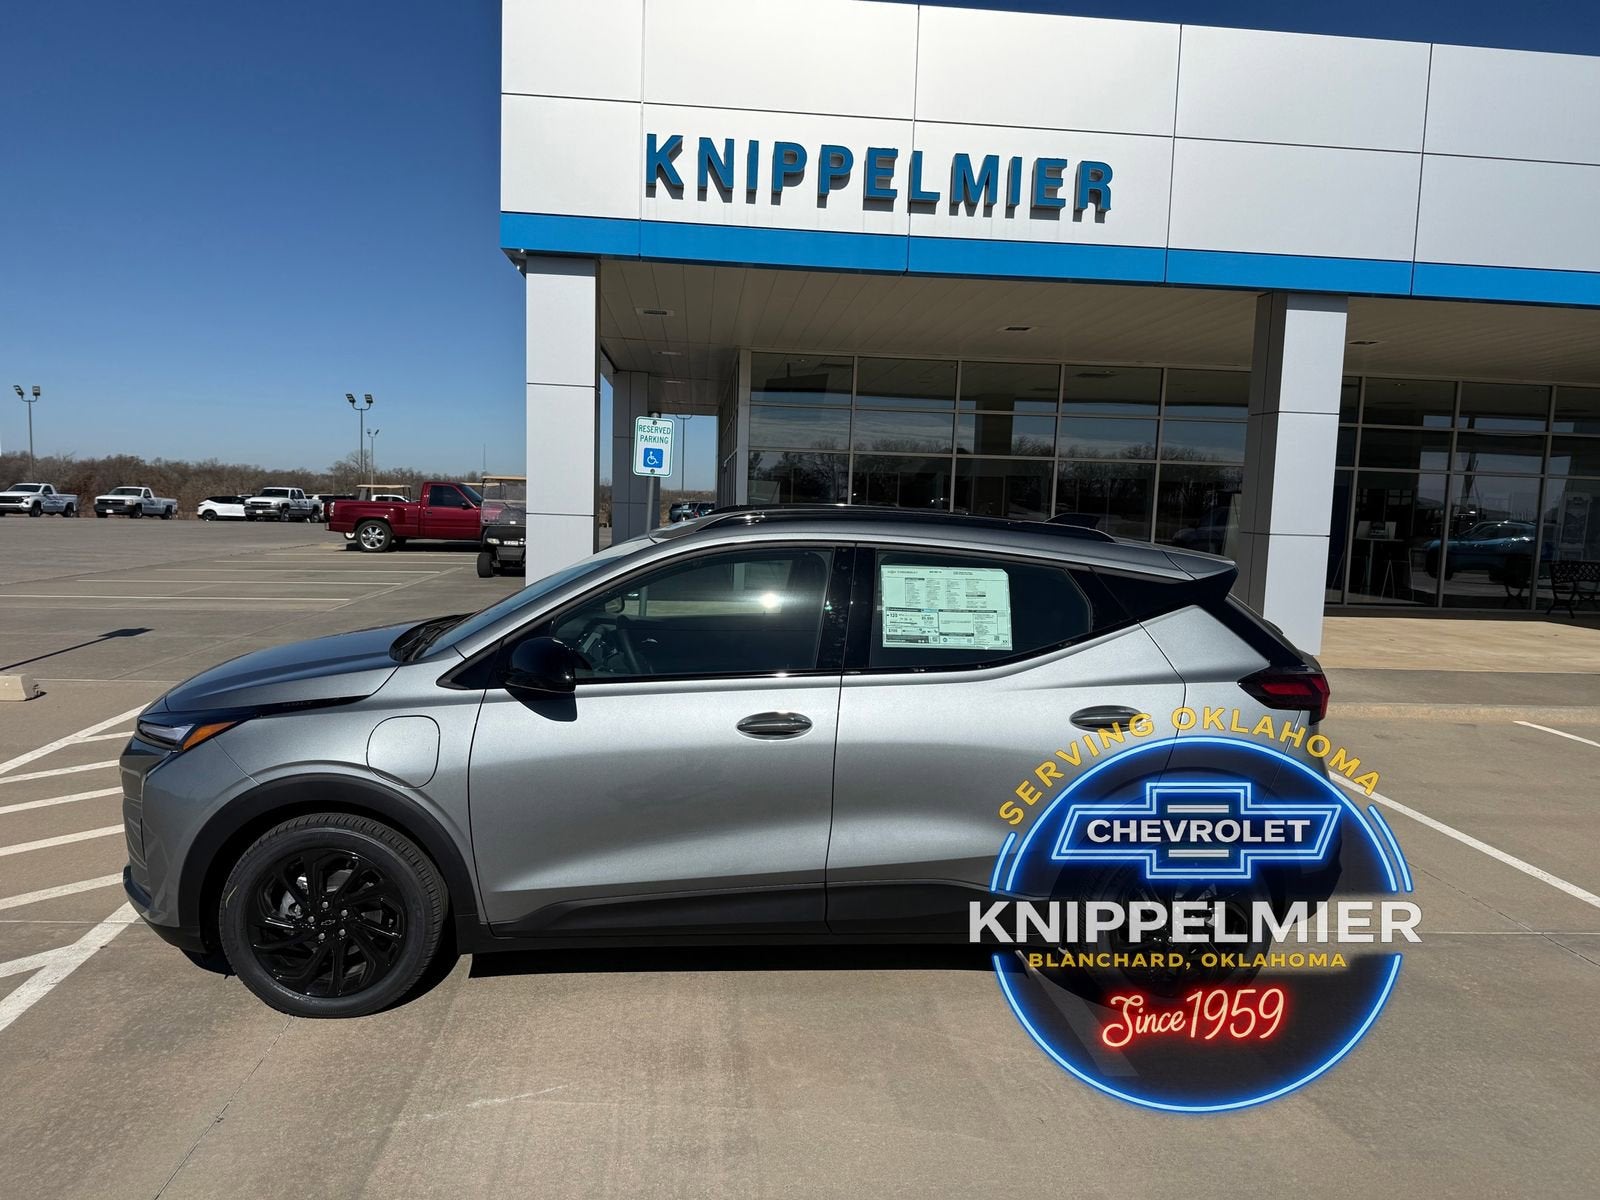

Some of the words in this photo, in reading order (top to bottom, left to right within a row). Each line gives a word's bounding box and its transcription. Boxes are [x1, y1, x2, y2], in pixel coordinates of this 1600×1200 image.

[646, 133, 1114, 214] KNIPPELMIER
[638, 425, 671, 435] RESERVED
[640, 434, 669, 444] PARKING
